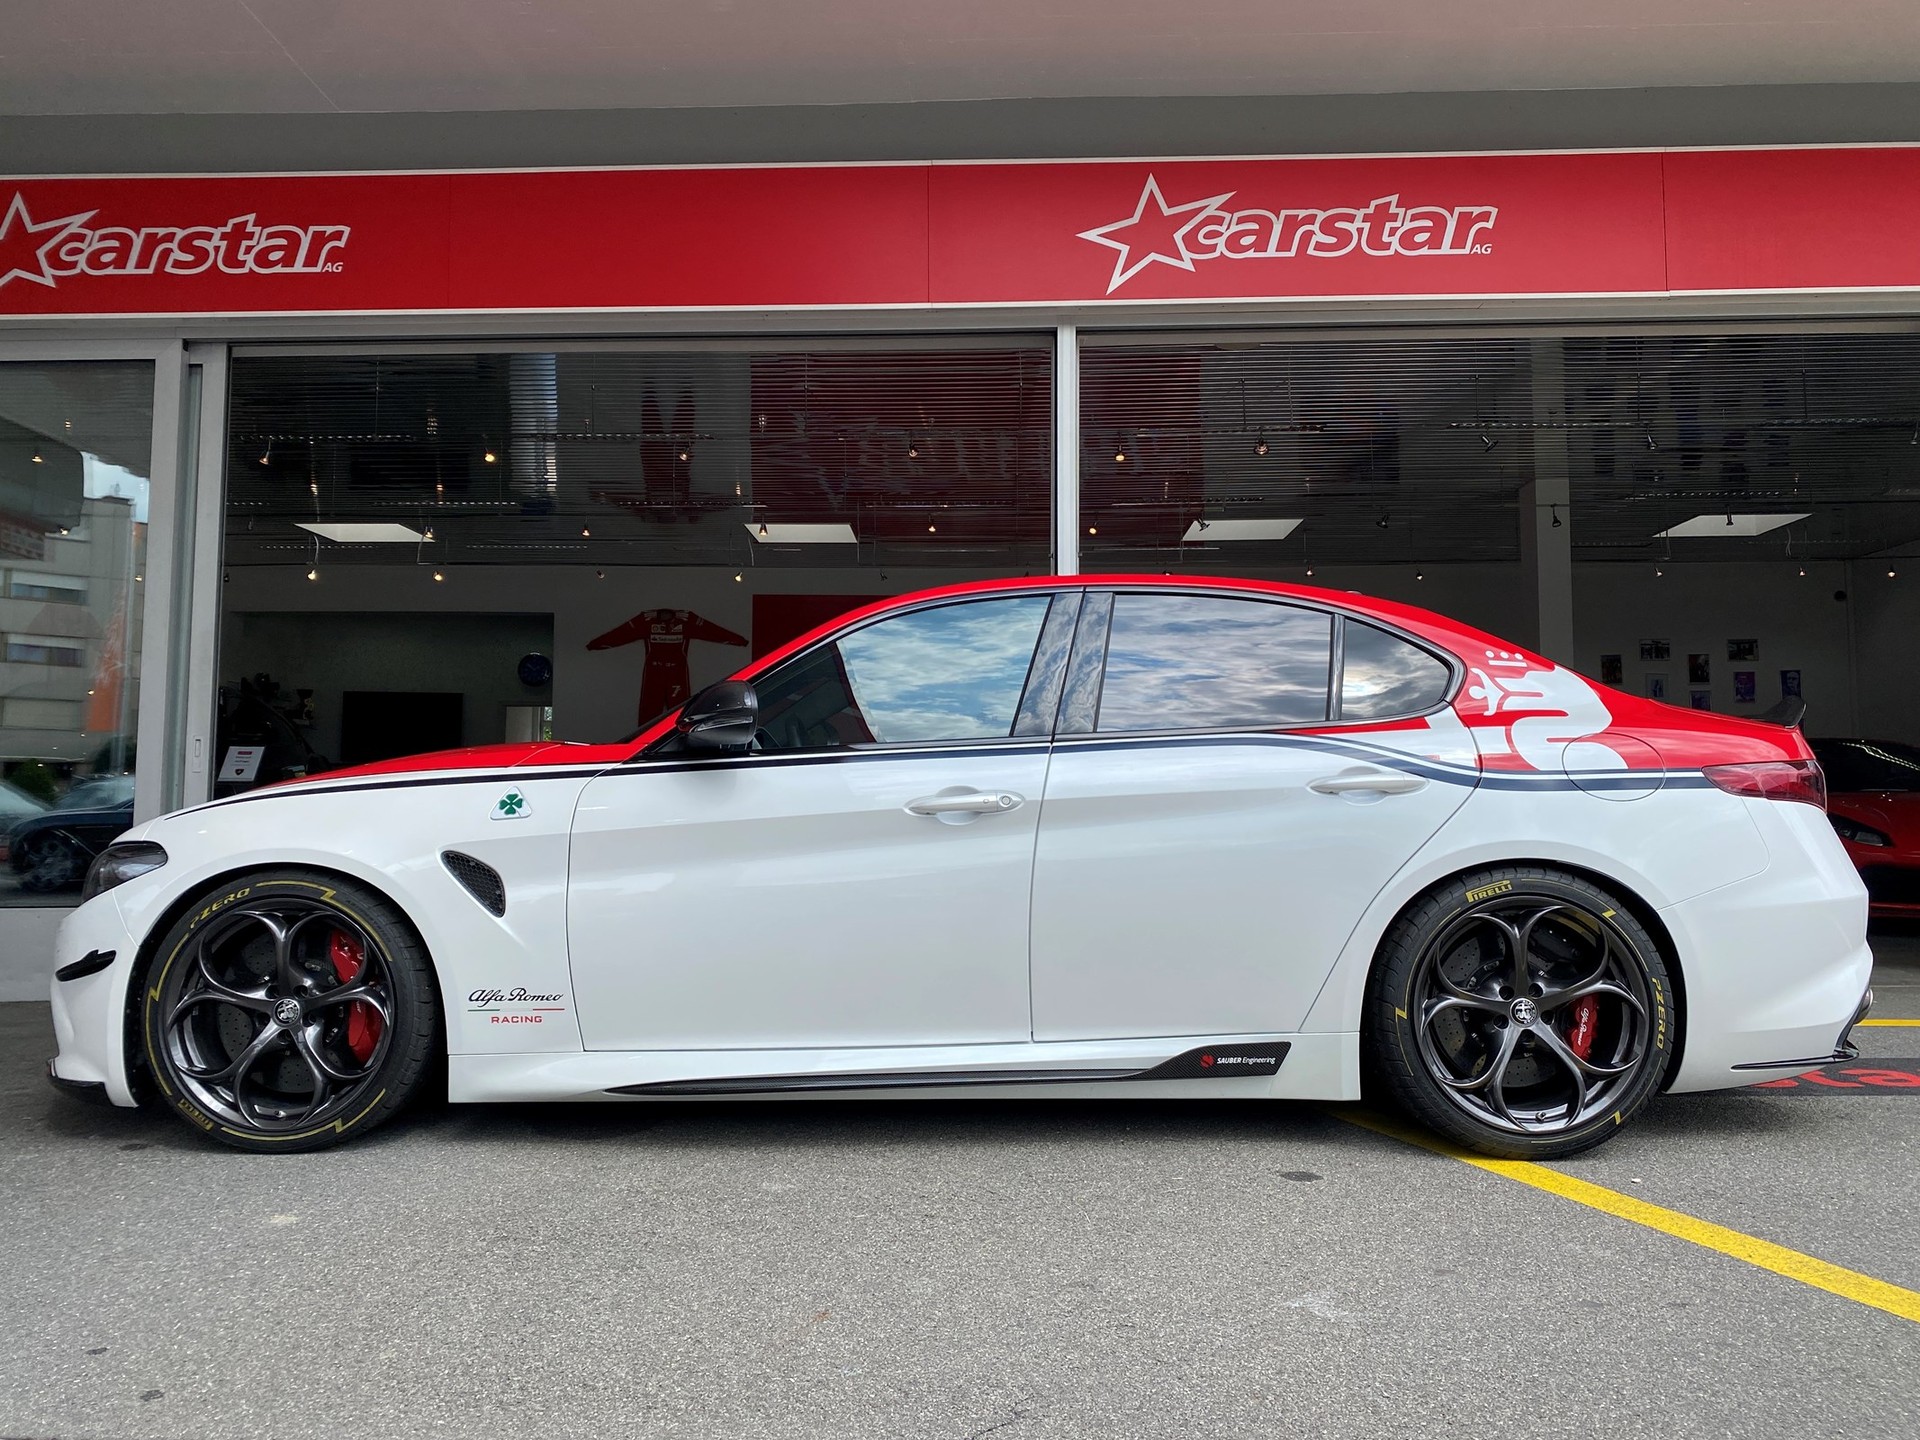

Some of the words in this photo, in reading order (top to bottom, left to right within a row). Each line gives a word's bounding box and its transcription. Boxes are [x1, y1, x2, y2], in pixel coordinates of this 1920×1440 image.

[1179, 193, 1498, 258] carstar
[1470, 243, 1492, 255] AG
[44, 212, 351, 276] carstar
[322, 261, 344, 273] AG
[671, 685, 682, 698] 7
[1465, 879, 1513, 903] PIRELLI
[468, 989, 507, 1008] Alfa
[507, 987, 564, 1002] Romeo
[490, 1015, 543, 1024] RACING
[1216, 1056, 1242, 1065] SAUBER
[1242, 1056, 1276, 1065] Engineering
